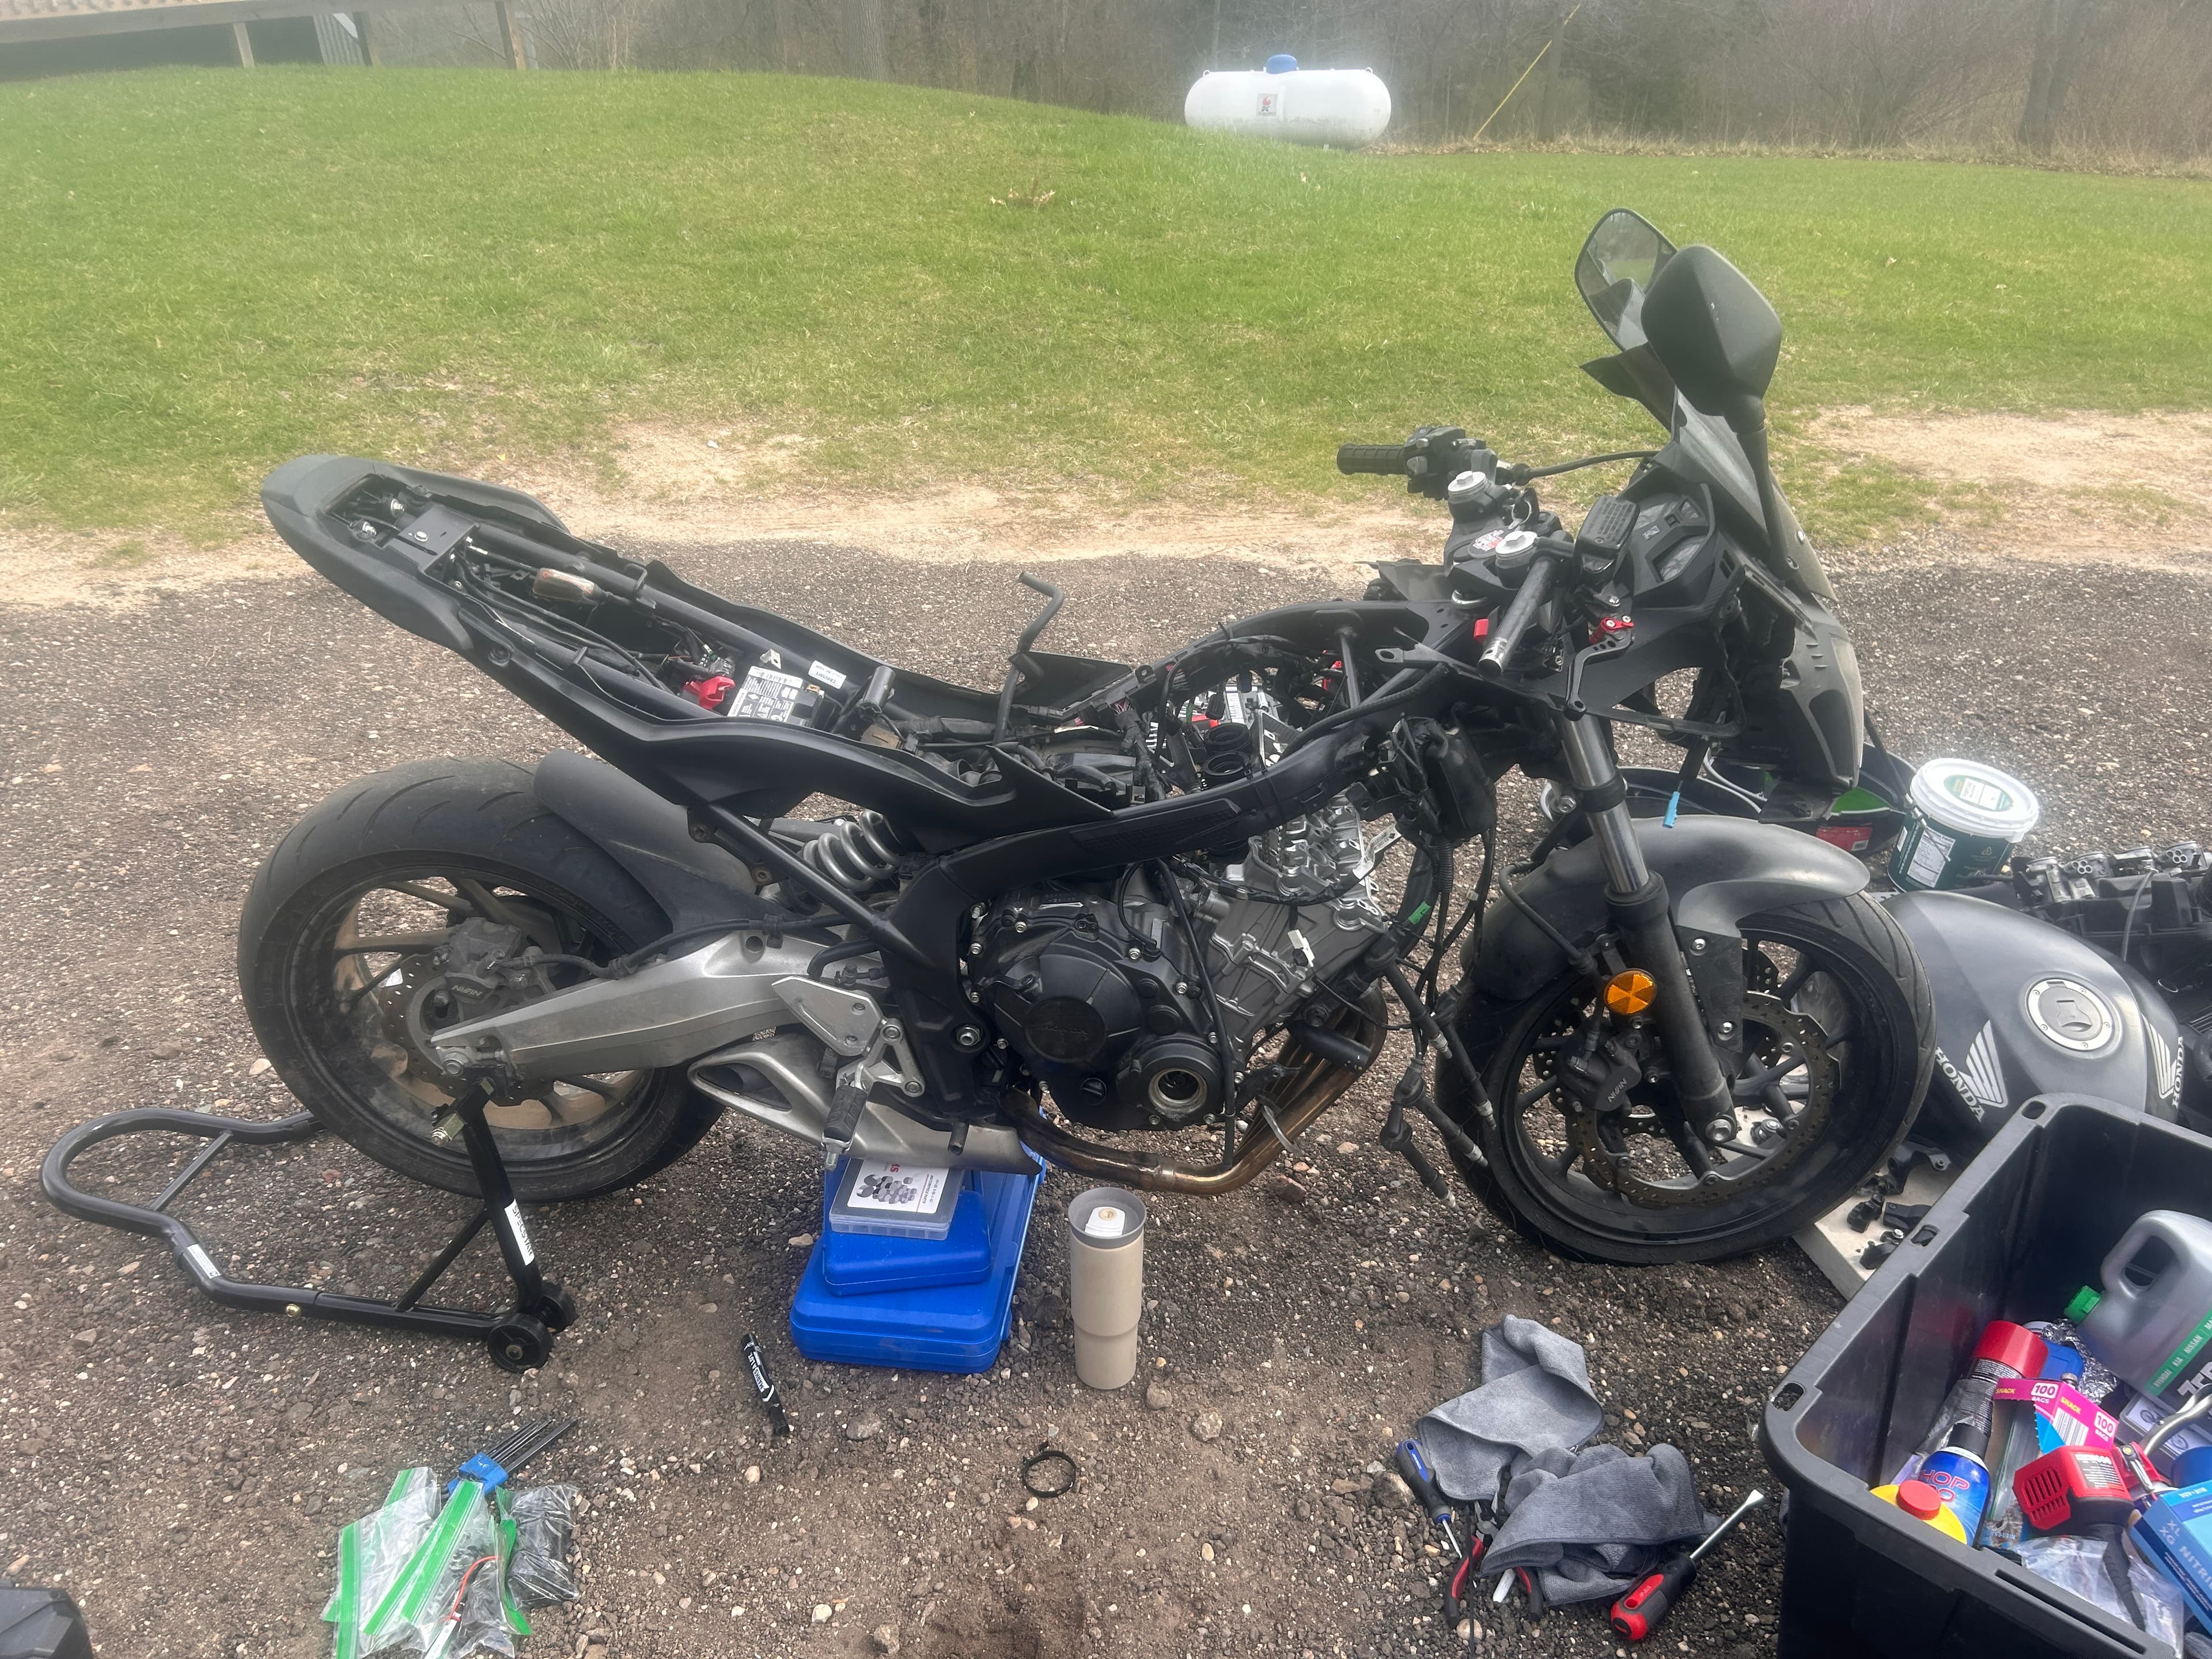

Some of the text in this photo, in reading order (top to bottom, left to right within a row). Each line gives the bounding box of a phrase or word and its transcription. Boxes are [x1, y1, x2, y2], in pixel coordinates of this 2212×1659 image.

[2172, 1036, 2184, 1109] HONDA
[1934, 1047, 1985, 1123] HONDA
[2153, 1368, 2173, 1388] HYUNDAI
[2171, 1357, 2184, 1368] KIA
[2183, 1334, 2203, 1354] NISSAN
[2031, 1396, 2050, 1404] BAGS
[2033, 1385, 2056, 1396] 100
[2060, 1396, 2082, 1415] SNACK
[2096, 1415, 2113, 1434] 100
[2094, 1429, 2109, 1442] BAGS
[1919, 1469, 1970, 1490] HOP
[2158, 1526, 2175, 1545] XG
[2166, 1519, 2180, 1537] XL
